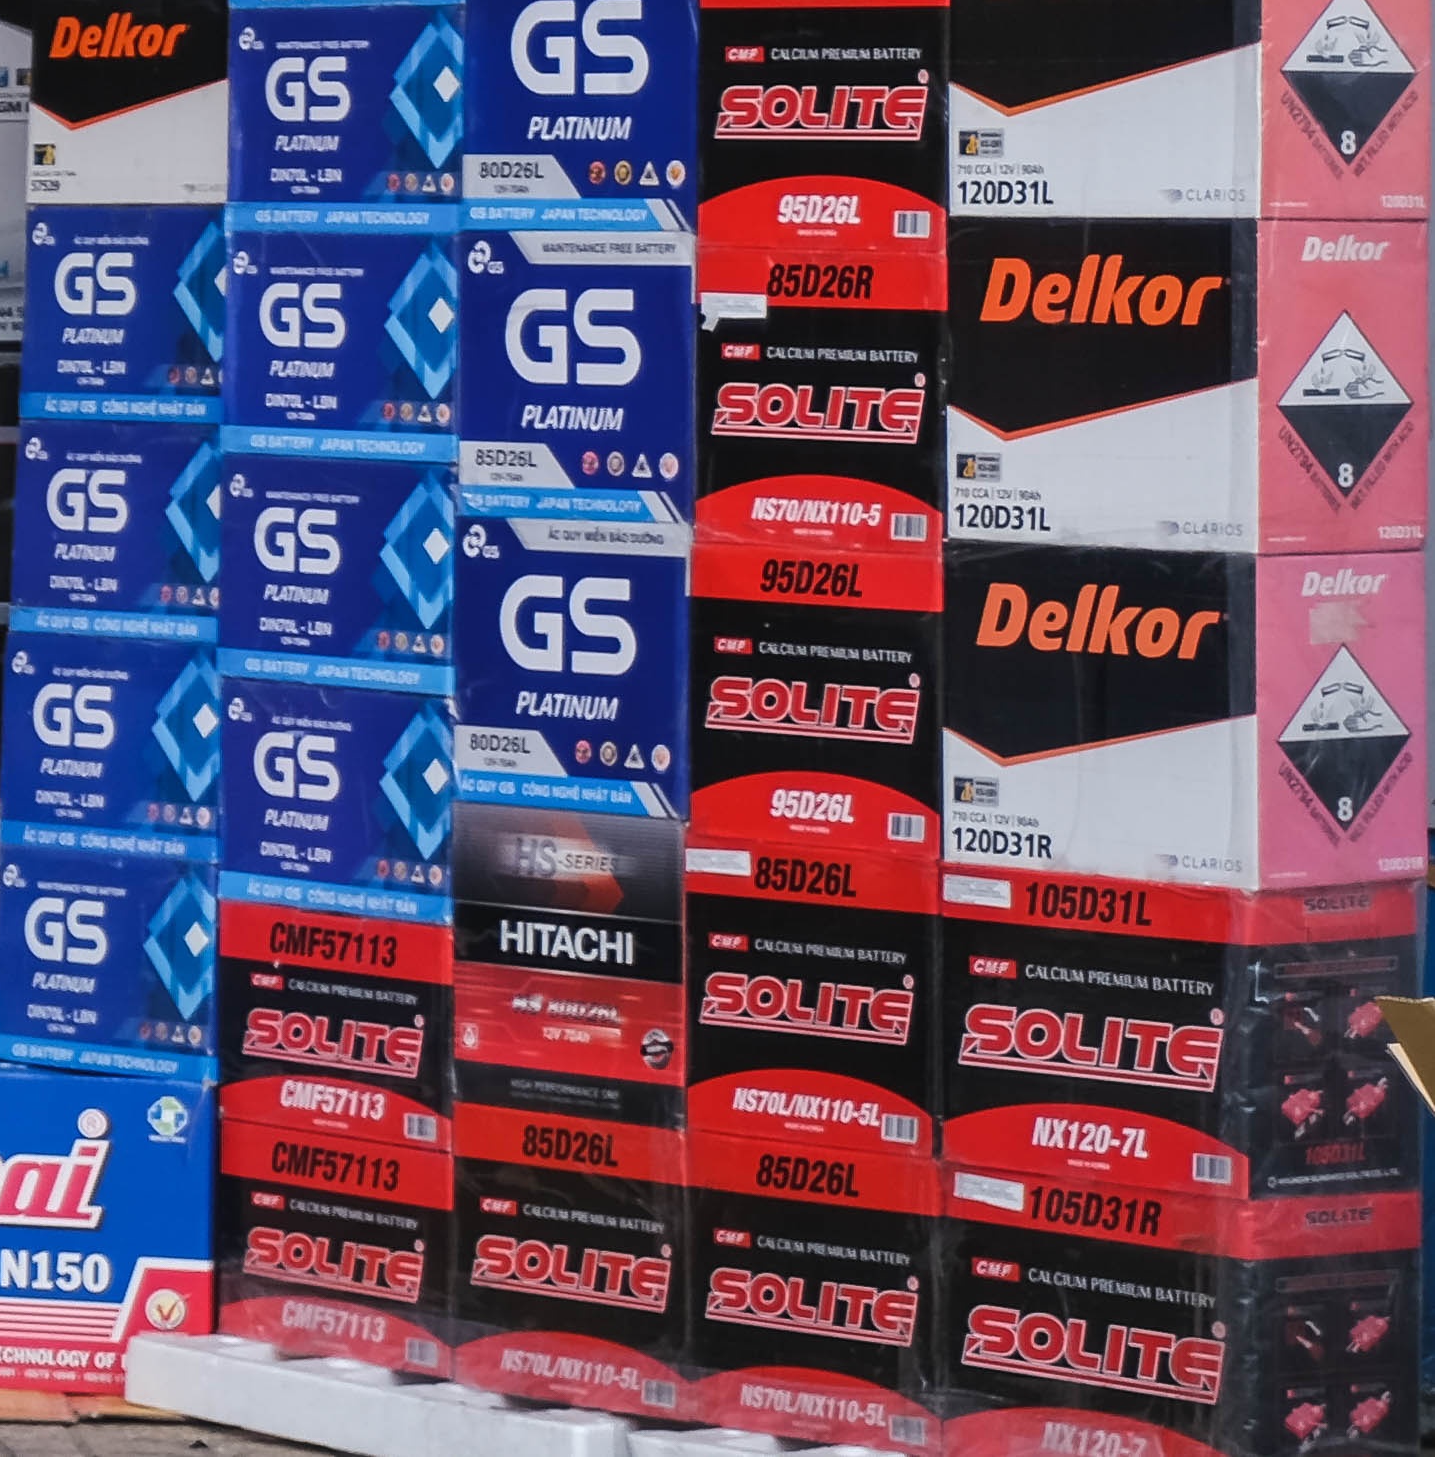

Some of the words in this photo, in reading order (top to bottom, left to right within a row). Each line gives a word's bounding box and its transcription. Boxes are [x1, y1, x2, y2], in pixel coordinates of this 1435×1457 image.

[771, 46, 819, 60] CALCIUM
[822, 47, 870, 60] PREMIUM
[873, 47, 922, 60] BATTERY
[528, 116, 631, 141] PLATINUM
[479, 162, 543, 180] 80D26L
[767, 263, 873, 299] 85D26R
[752, 496, 881, 527] NS70/NX110-5
[952, 826, 1052, 859] 120D31R
[1026, 882, 1152, 926] 105D31L
[269, 922, 398, 968] CMF57113
[500, 919, 634, 965] HITACHI
[1025, 964, 1085, 984] CALCIUM
[1088, 970, 1149, 990] PREMIUM
[1152, 977, 1214, 996] BATTERY
[1032, 1116, 1149, 1159] NX120-7L
[1030, 1186, 1162, 1236] 105D31R
[0, 1248, 111, 1293] N150
[962, 1304, 1226, 1401] SOLITE
